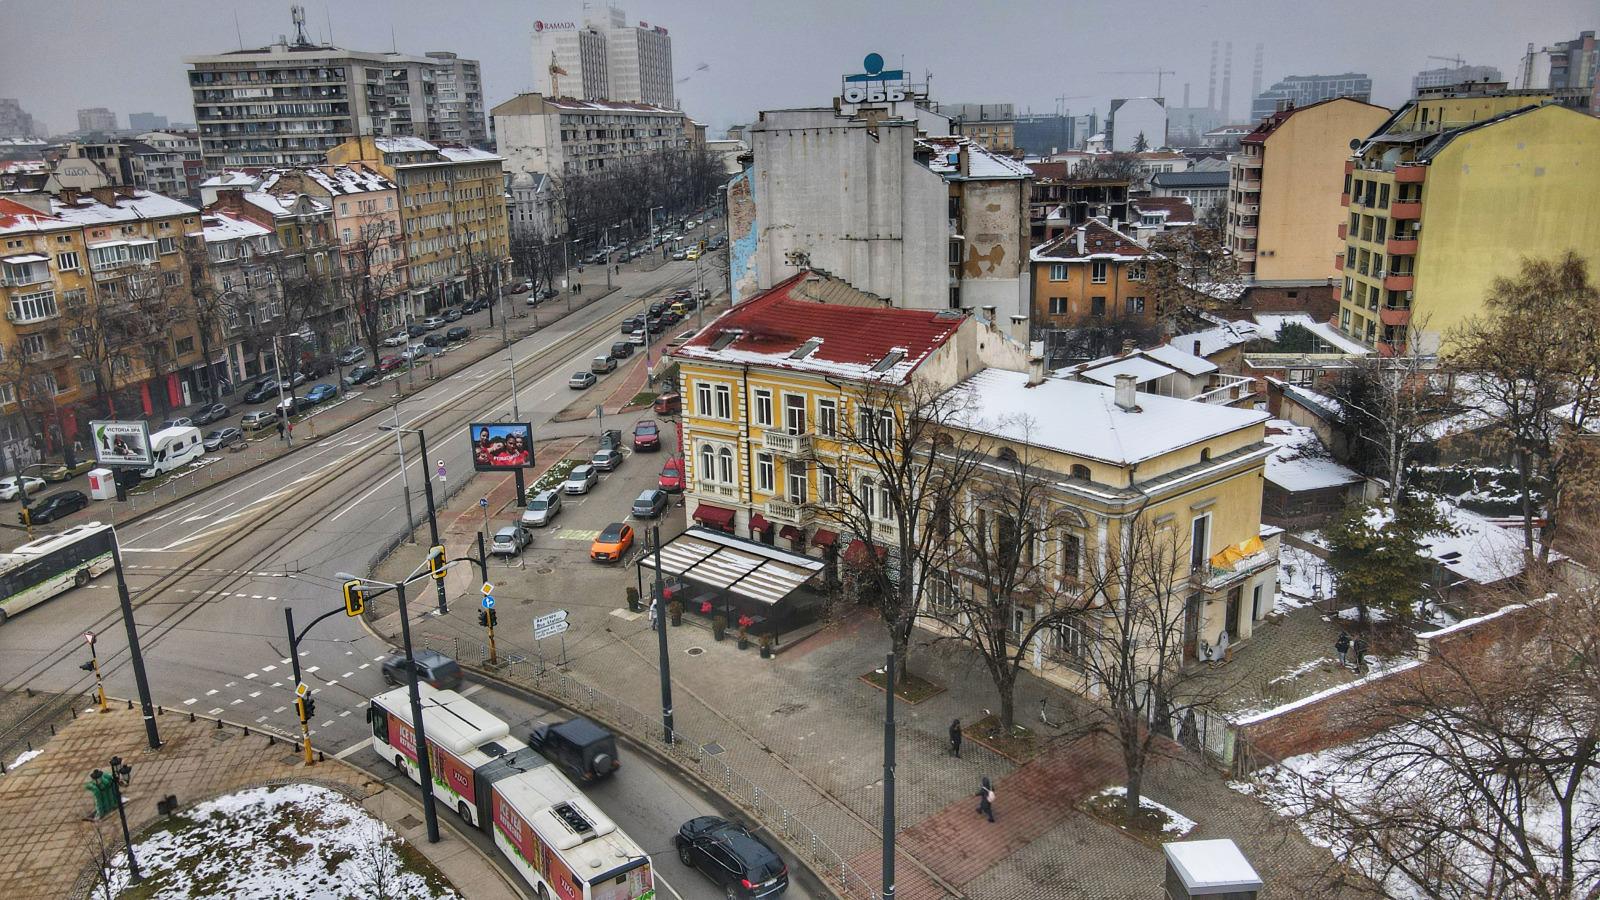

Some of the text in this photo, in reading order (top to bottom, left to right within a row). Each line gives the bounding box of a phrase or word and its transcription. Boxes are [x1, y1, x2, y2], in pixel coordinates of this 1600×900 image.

[544, 21, 576, 29] RAMADA
[844, 86, 906, 104] ОББ
[500, 799, 522, 833] ICE TEA
